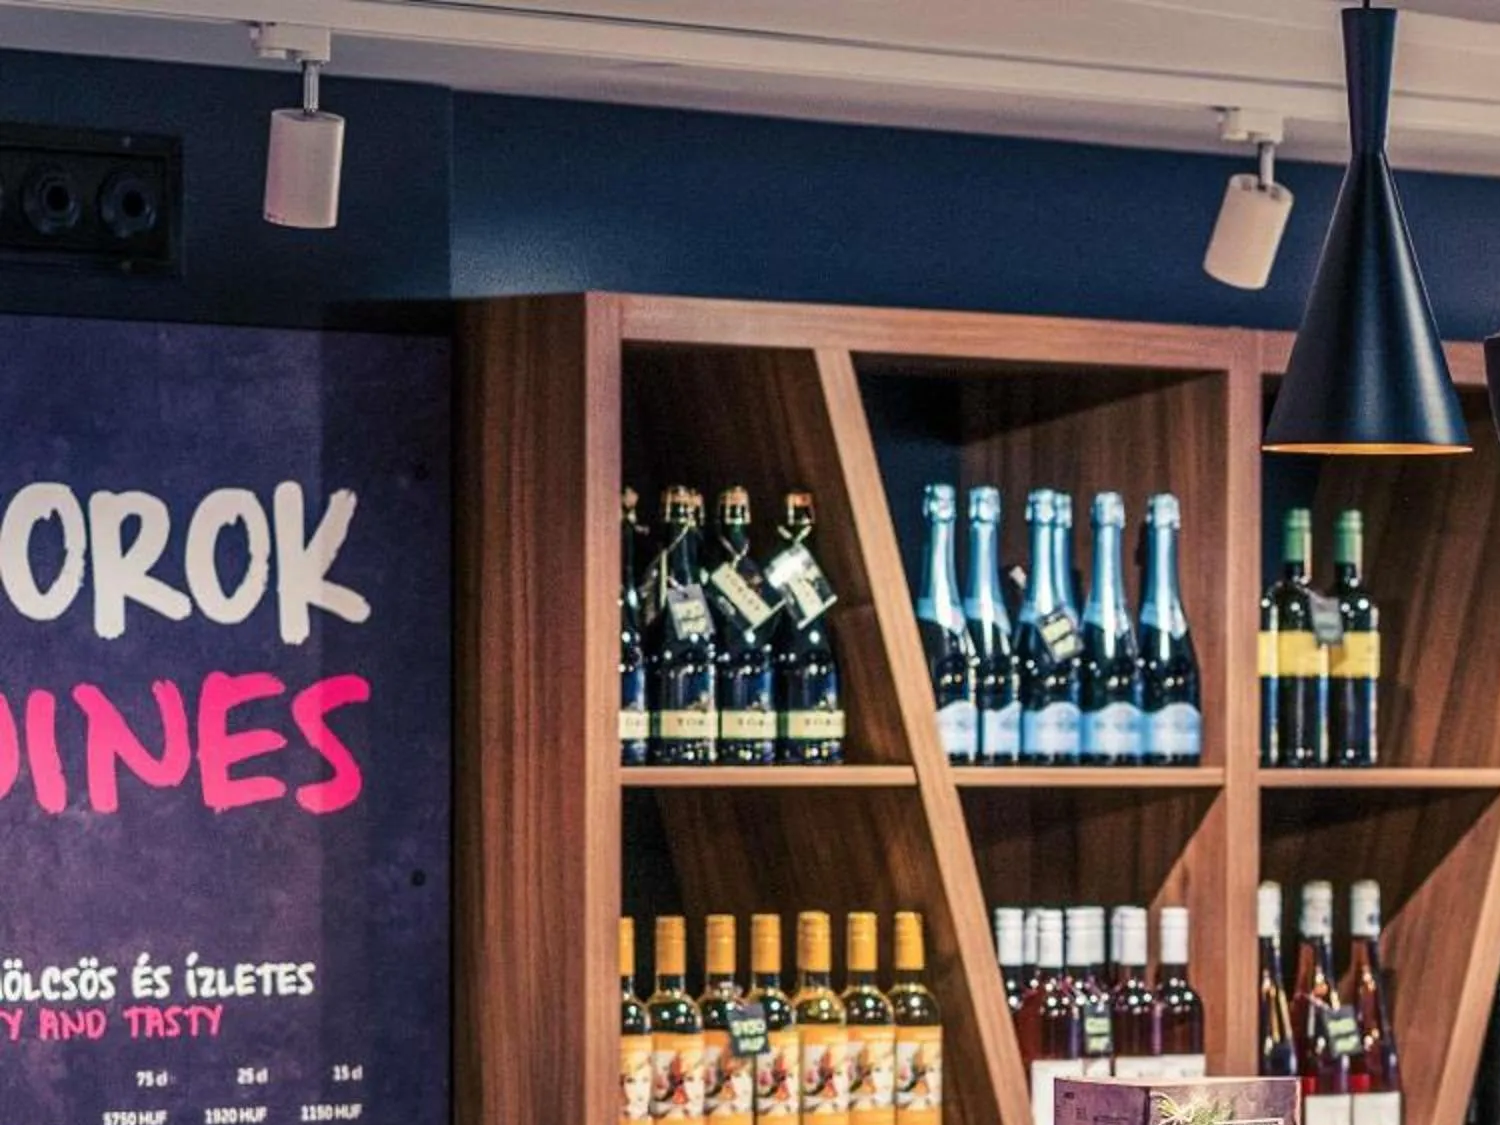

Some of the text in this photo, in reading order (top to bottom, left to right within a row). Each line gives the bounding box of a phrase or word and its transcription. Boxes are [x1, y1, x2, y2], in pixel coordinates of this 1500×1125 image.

[0, 951, 316, 1002] ÖLCSÖS ÉS ÍZLETES
[39, 1007, 107, 1041] AND
[123, 1004, 223, 1038] TASTY
[136, 1070, 155, 1087] 75
[237, 1067, 255, 1085] 25
[333, 1064, 350, 1081] 15
[239, 1106, 267, 1123] HUF
[333, 1103, 362, 1120] HUF
